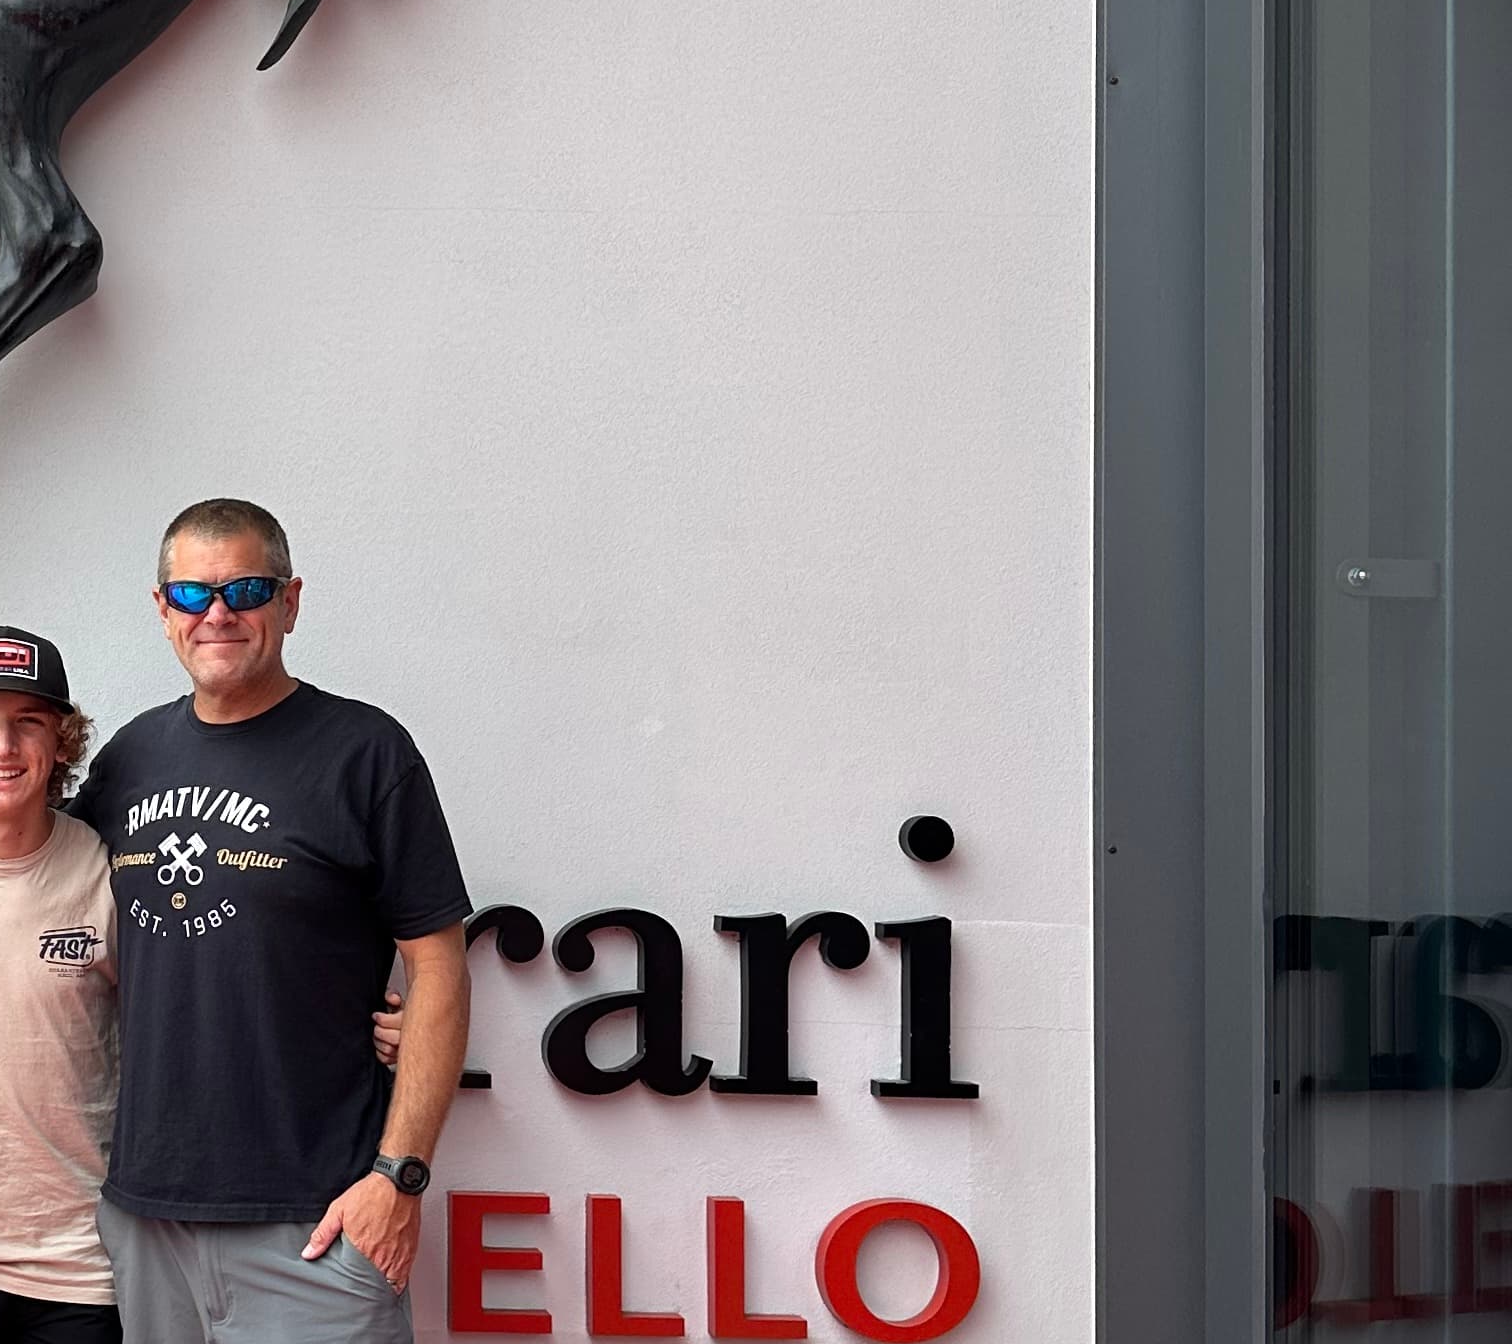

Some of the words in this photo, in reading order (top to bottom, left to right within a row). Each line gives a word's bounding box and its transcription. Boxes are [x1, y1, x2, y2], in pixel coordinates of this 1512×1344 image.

[127, 785, 270, 837] RMATV/MC
[216, 848, 288, 871] Outfitter
[129, 898, 167, 937] EST.
[182, 898, 237, 938] 1985
